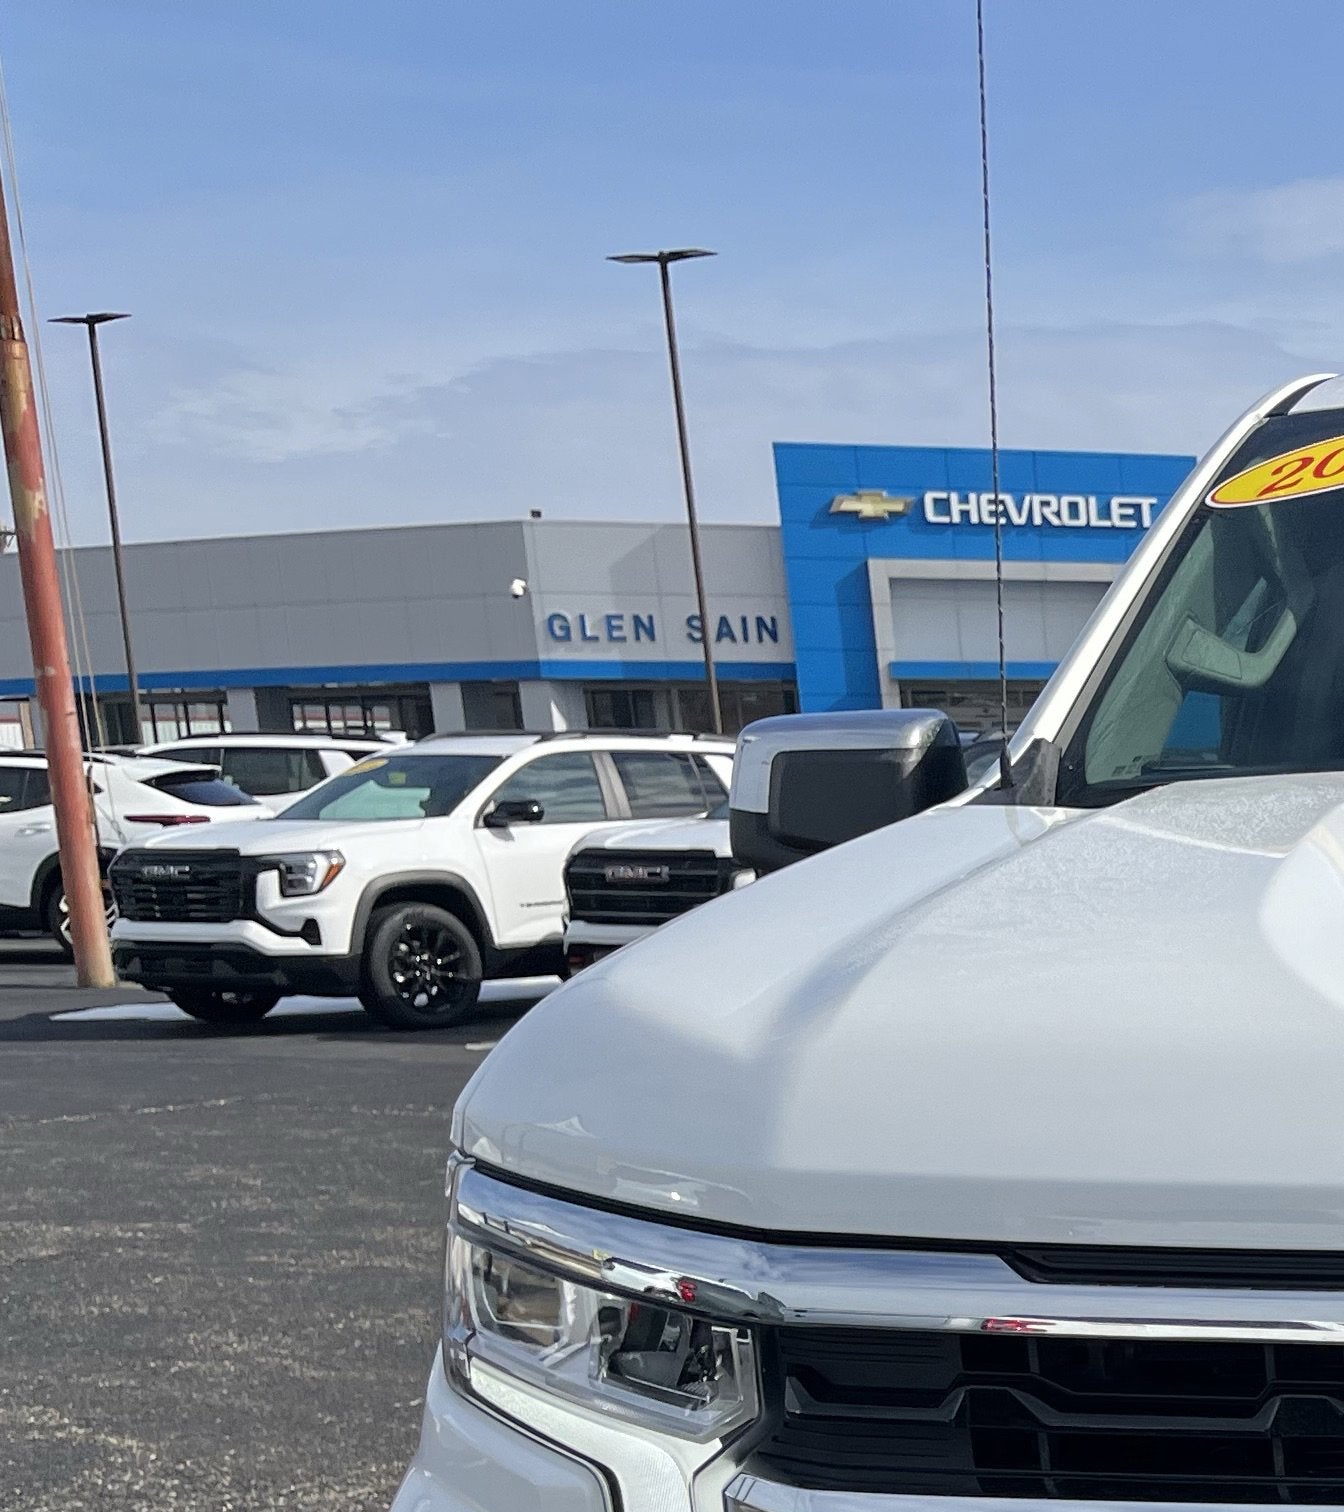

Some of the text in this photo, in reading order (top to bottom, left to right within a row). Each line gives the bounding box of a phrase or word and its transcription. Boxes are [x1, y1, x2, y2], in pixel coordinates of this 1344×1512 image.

[923, 491, 1158, 528] CHEVROLET
[547, 613, 779, 643] GLEN SAIN
